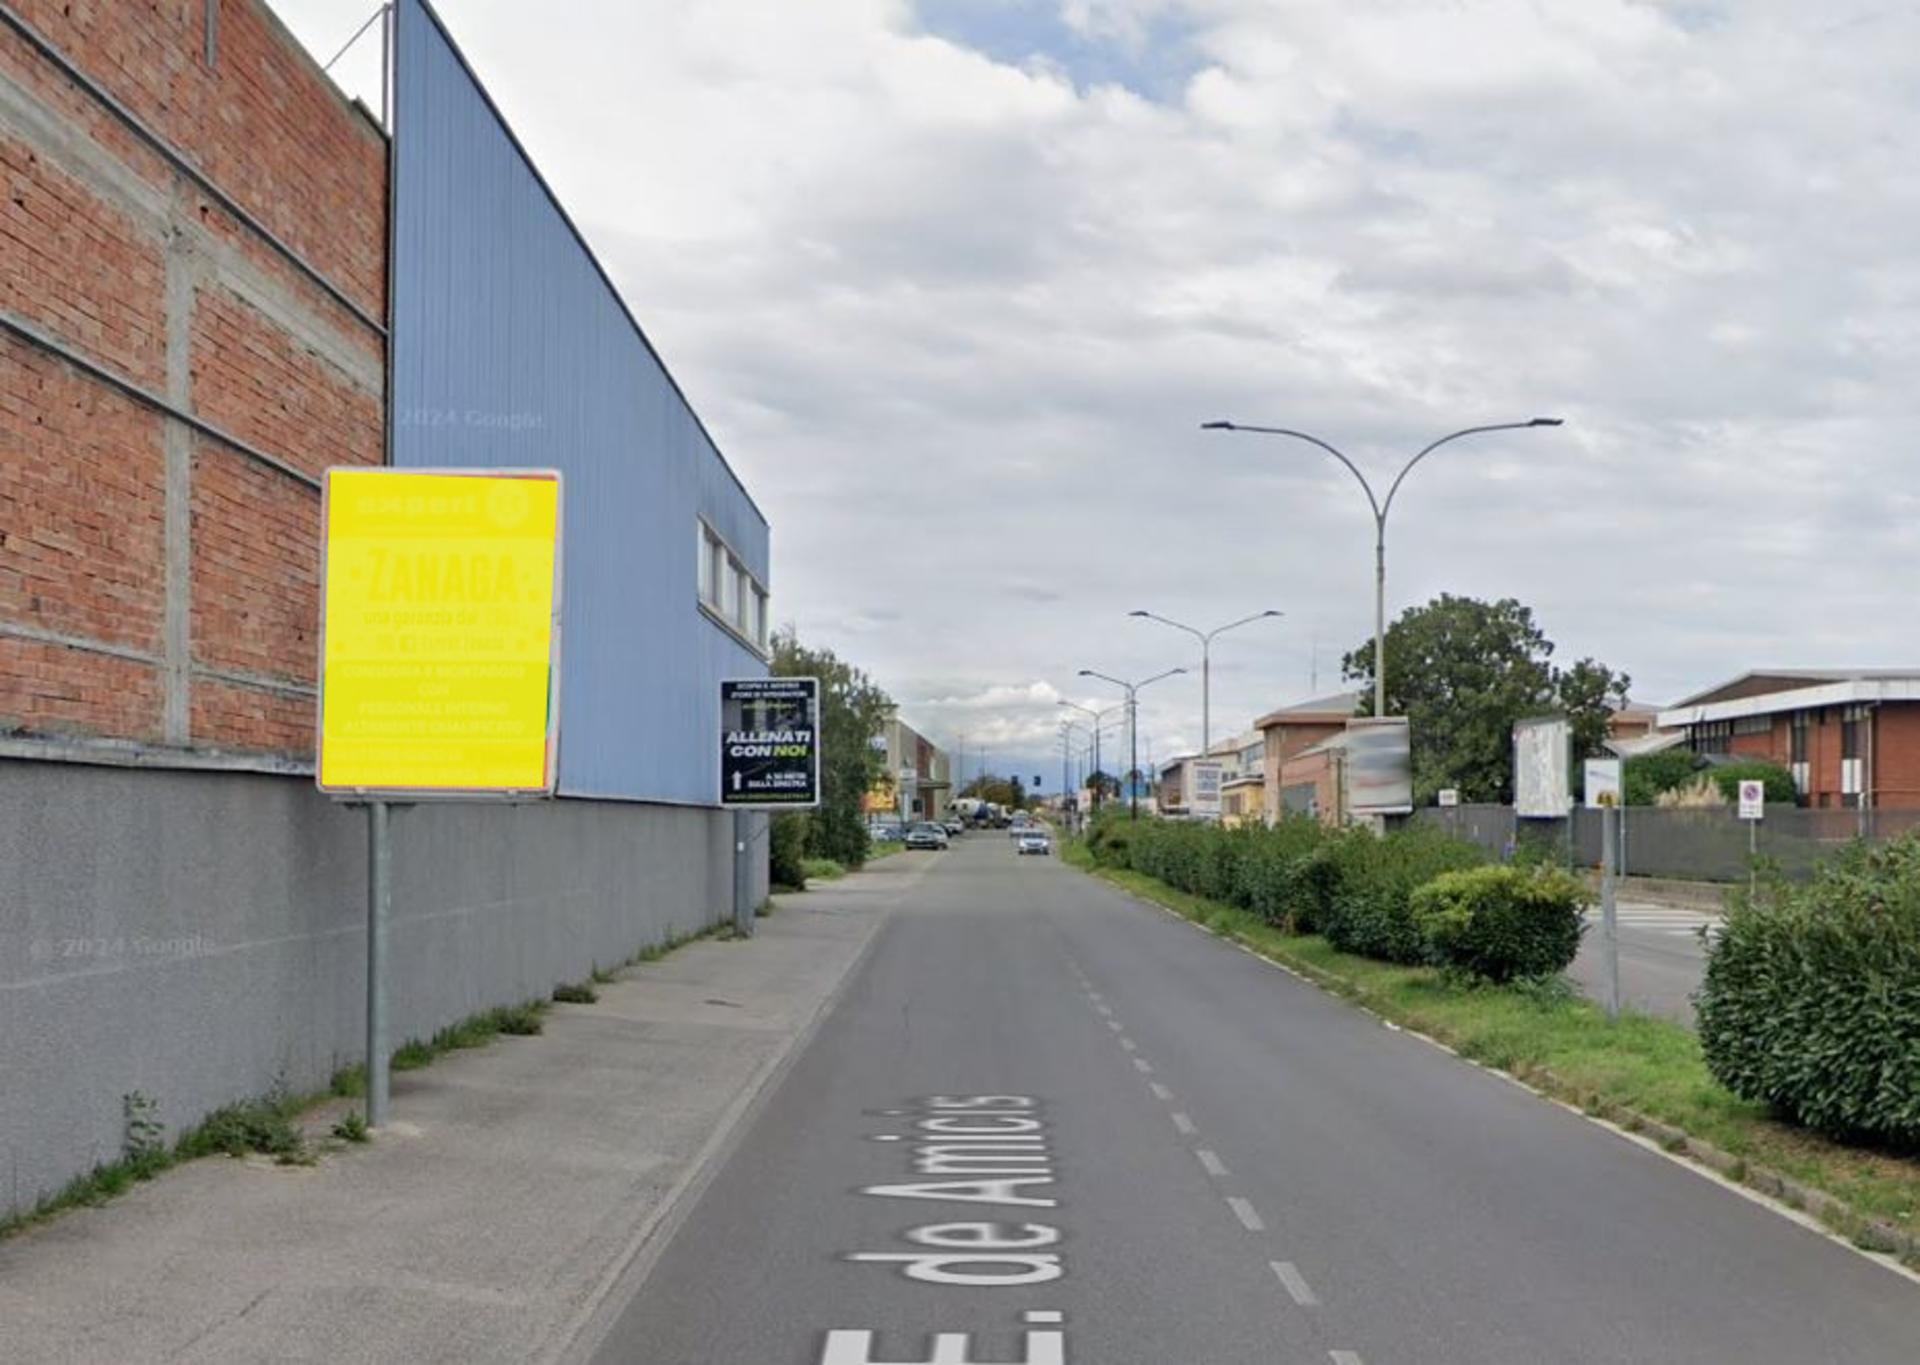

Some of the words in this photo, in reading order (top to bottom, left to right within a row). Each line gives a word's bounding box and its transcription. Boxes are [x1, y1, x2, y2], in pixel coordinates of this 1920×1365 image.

[367, 547, 518, 602] ZANAGA
[726, 731, 811, 743] ALLENATI
[730, 745, 772, 757] CON
[773, 745, 808, 757] NOI
